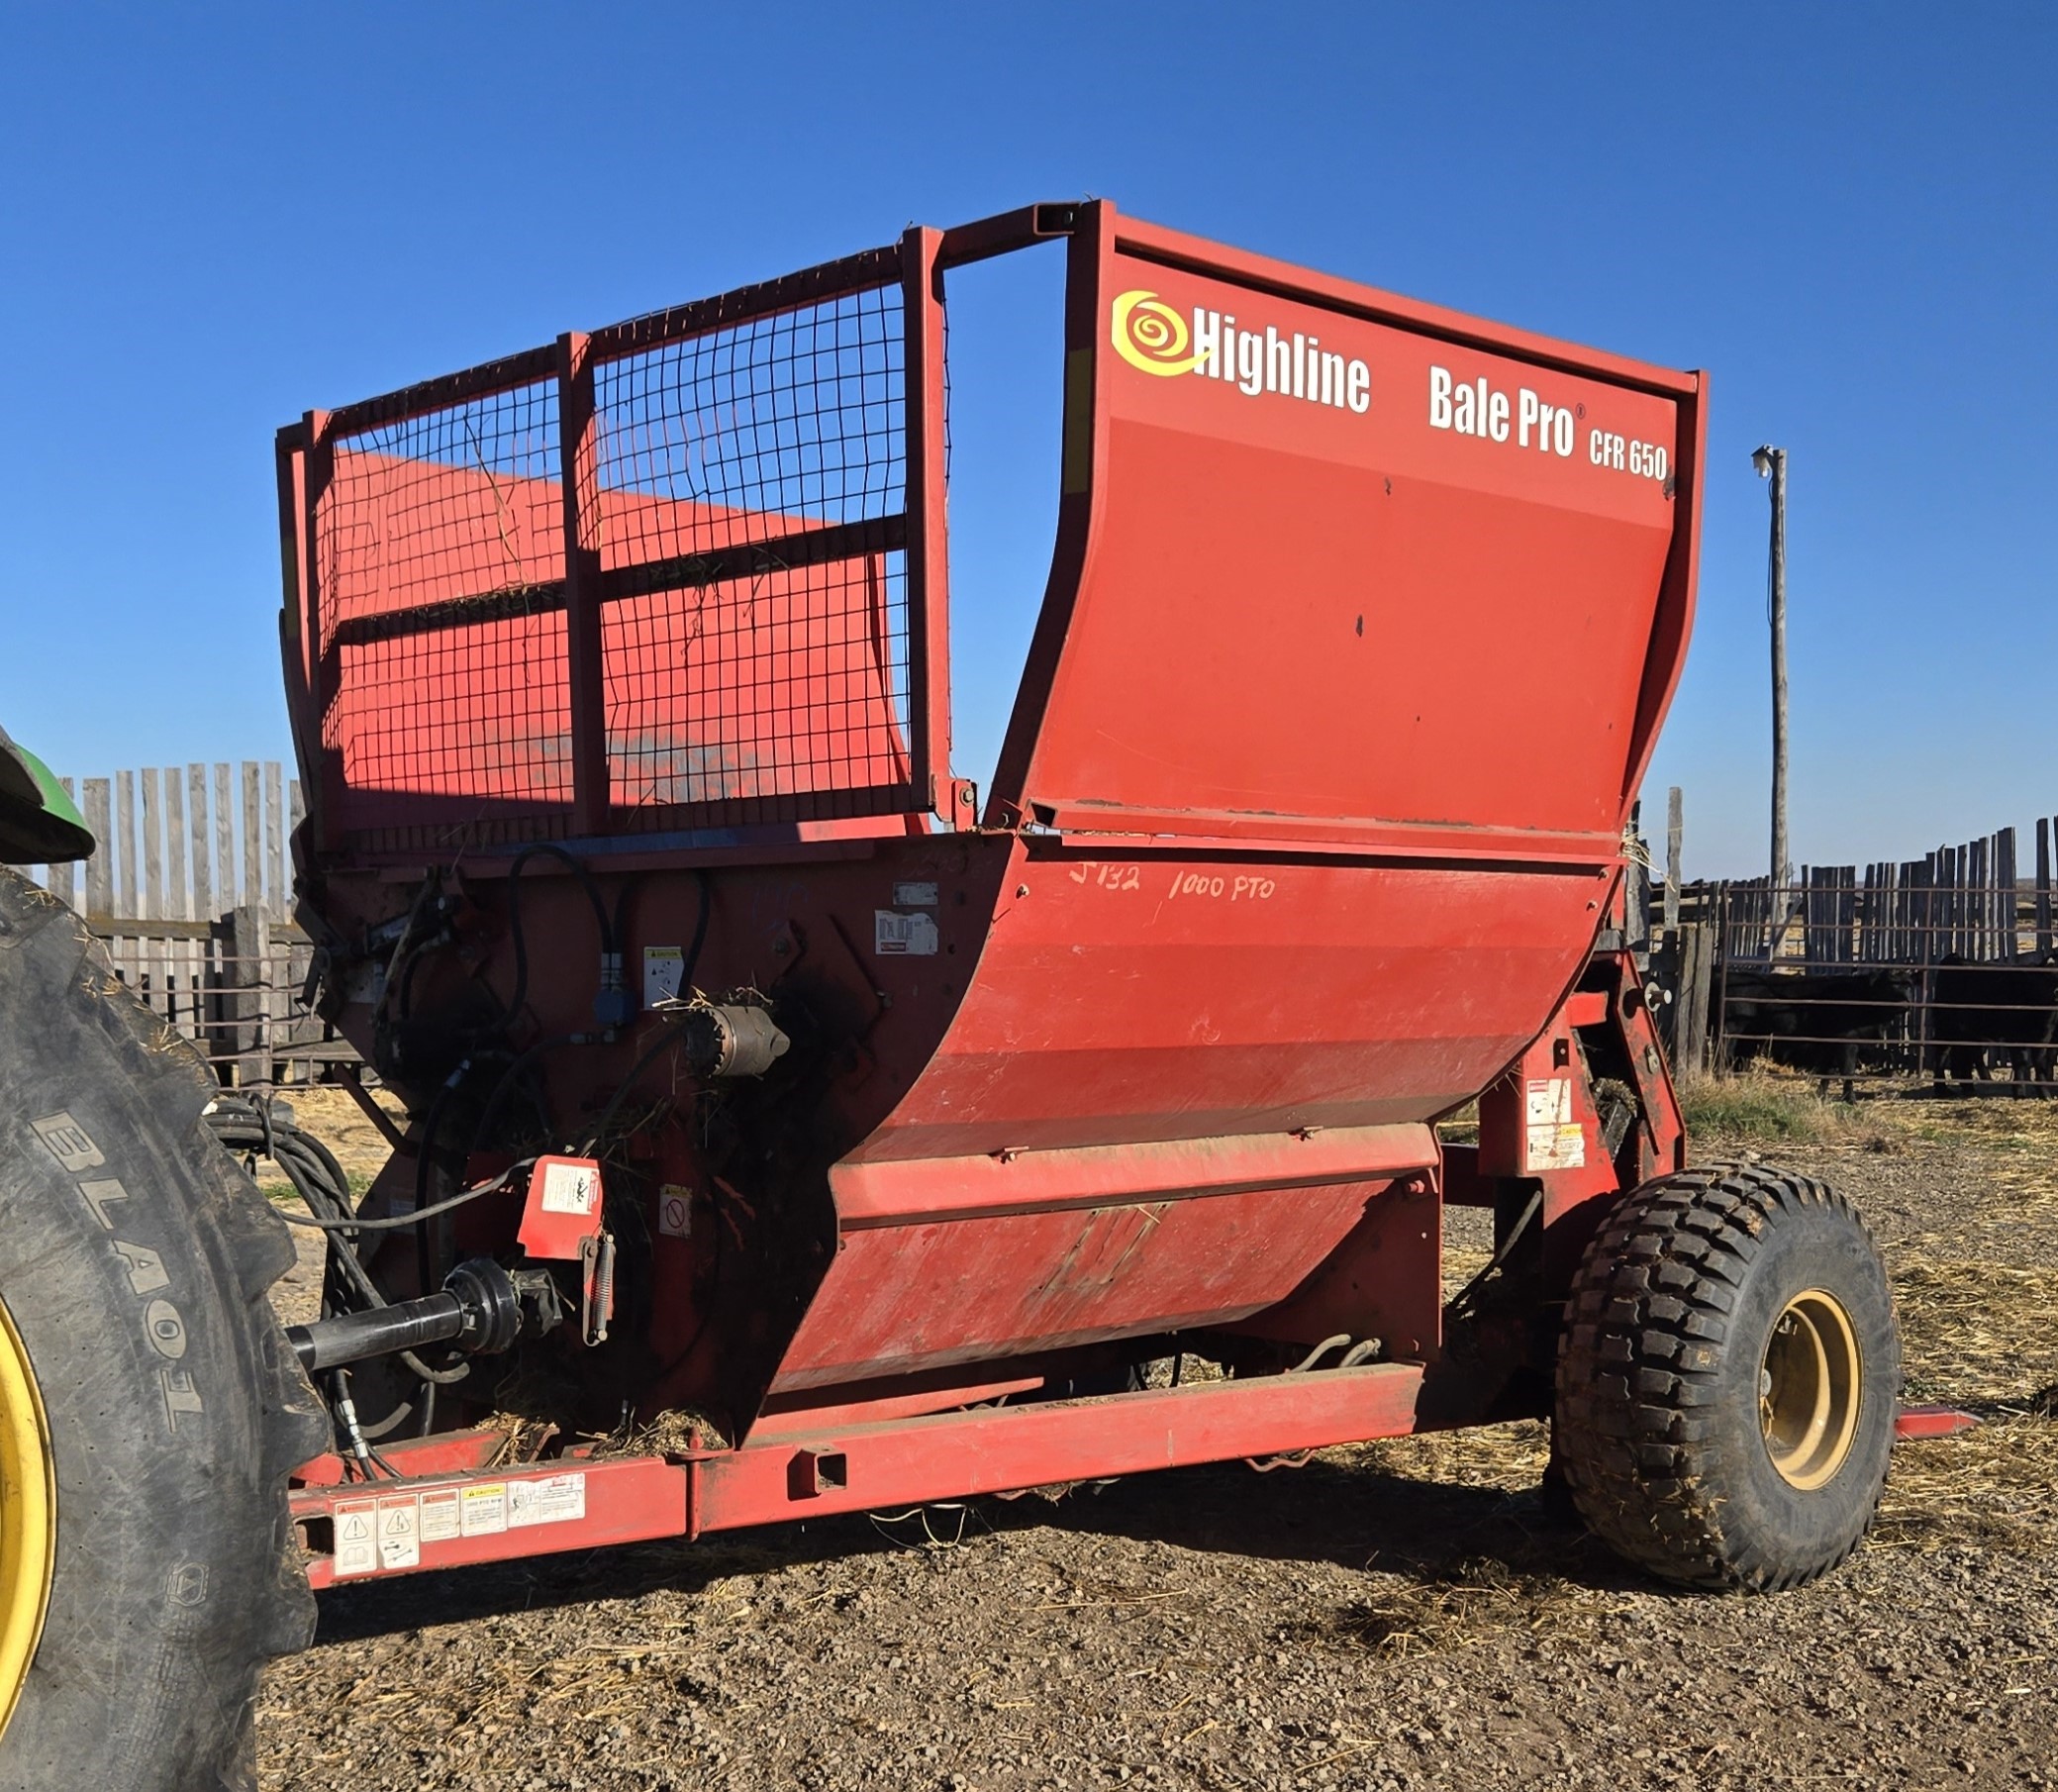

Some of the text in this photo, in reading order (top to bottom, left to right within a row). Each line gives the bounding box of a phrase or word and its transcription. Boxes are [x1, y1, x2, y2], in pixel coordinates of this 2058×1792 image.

[1193, 307, 1370, 414] Highline
[1429, 364, 1574, 457] Bale Pro
[1589, 428, 1668, 481] CFR 650
[1168, 870, 1225, 899] 1000
[1230, 875, 1276, 901] PTO
